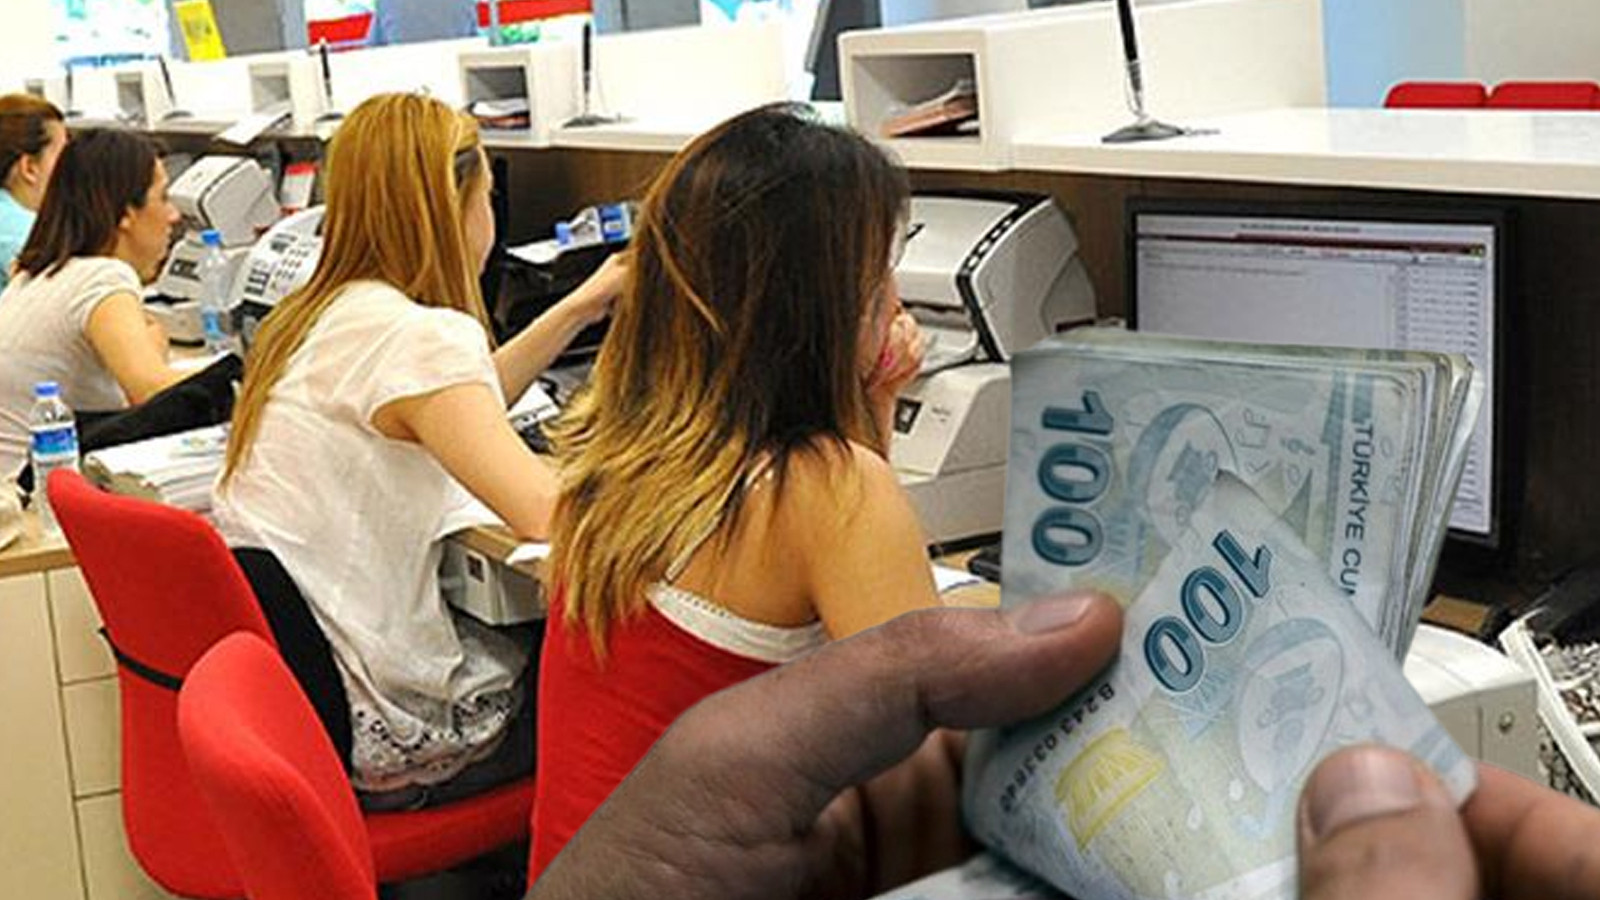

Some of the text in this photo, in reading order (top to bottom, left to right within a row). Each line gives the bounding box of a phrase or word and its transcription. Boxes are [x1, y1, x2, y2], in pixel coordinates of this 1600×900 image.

[1032, 390, 1114, 567] 100
[1340, 423, 1374, 595] TÜRKİYE CU
[1143, 529, 1273, 692] 100
